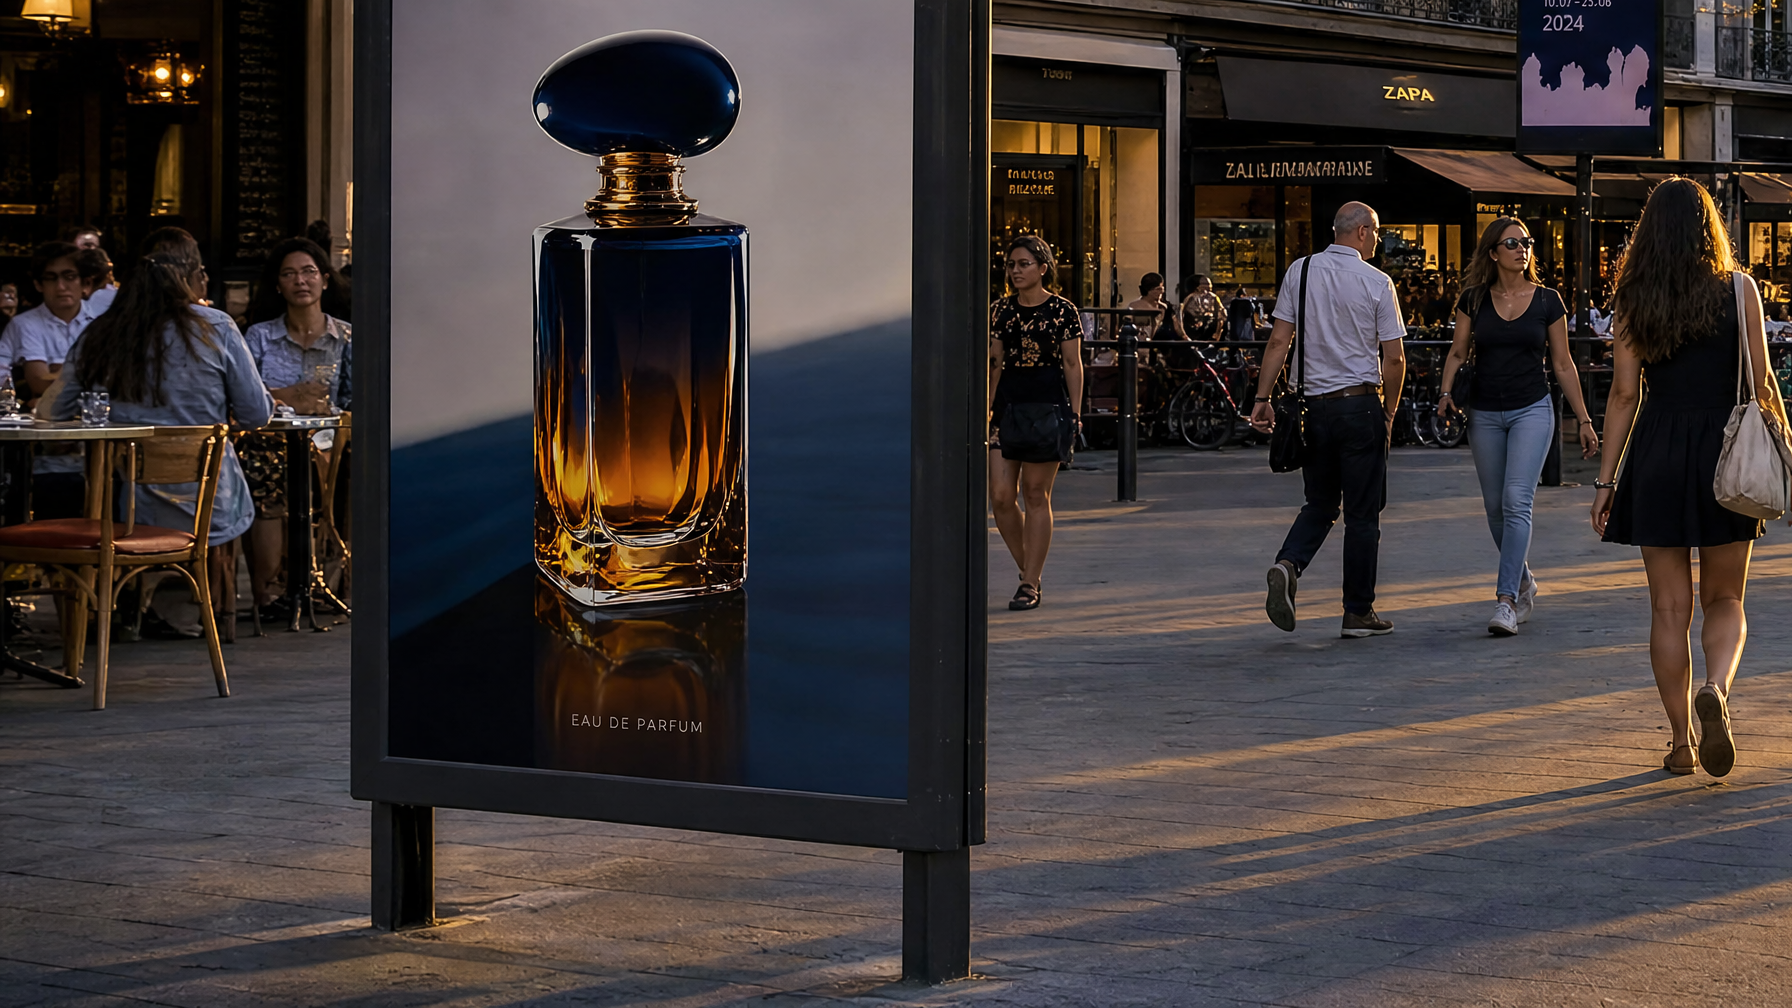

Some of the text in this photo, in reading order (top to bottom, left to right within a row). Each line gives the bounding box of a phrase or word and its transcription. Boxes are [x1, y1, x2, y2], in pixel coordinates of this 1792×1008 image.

[1542, 14, 1585, 32] 2024
[1382, 85, 1436, 102] ZAPA
[571, 713, 703, 733] EAU DE PARFUM
